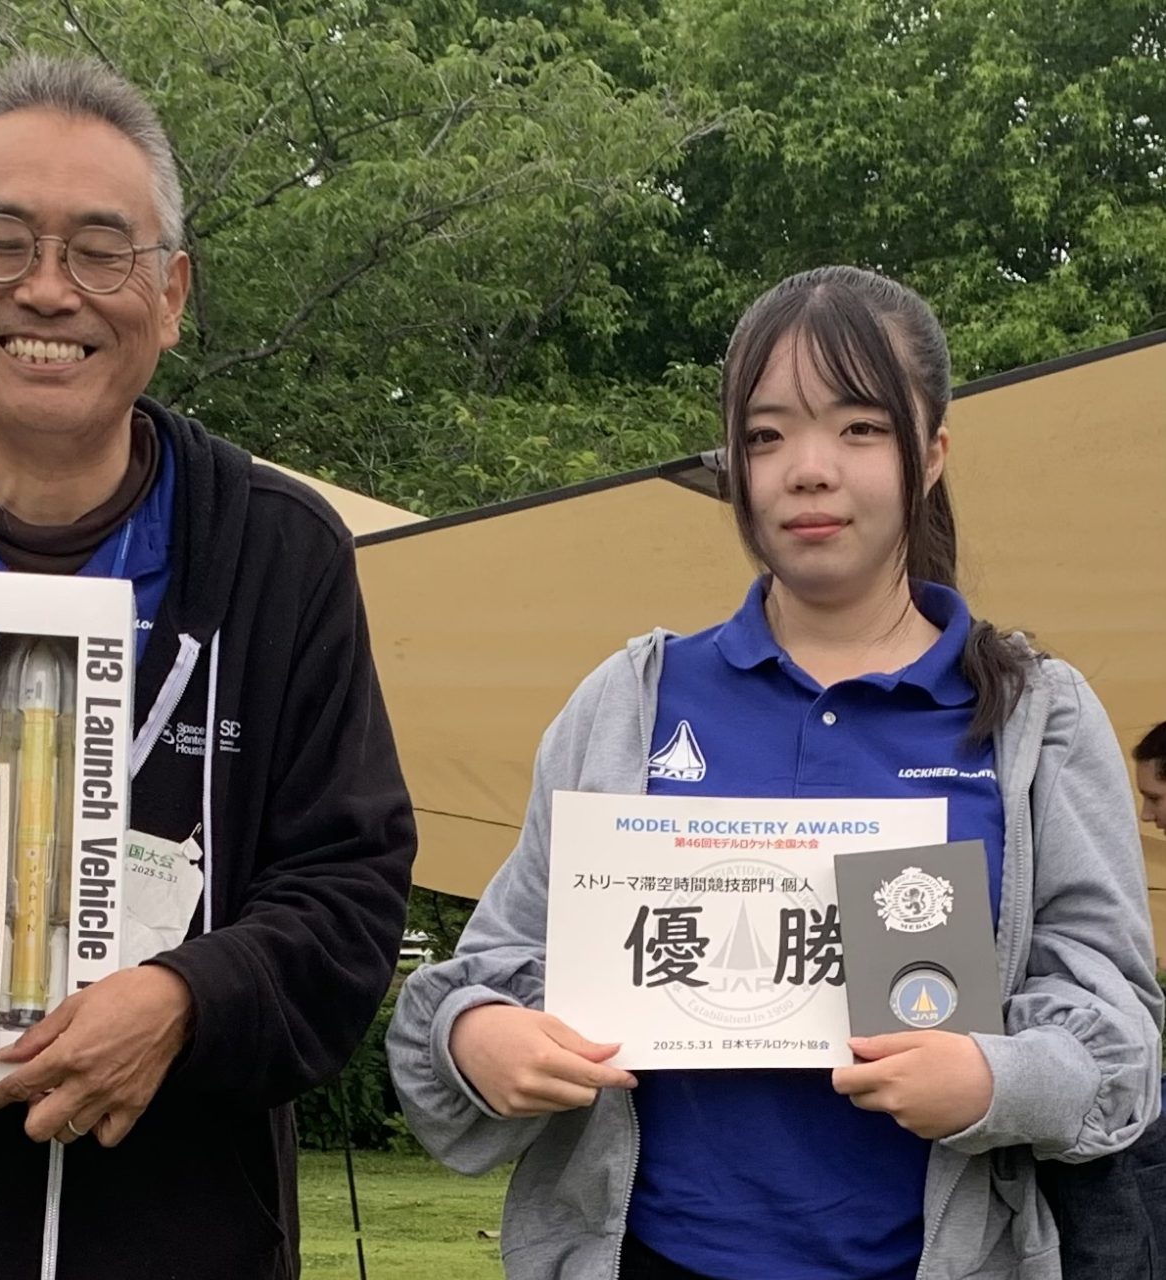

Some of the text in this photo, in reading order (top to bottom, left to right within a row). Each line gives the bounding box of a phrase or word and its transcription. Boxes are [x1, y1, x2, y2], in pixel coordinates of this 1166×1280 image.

[86, 636, 123, 683] H3
[176, 722, 206, 735] Space
[175, 733, 207, 746] Cente
[82, 696, 122, 820] Launch
[898, 767, 958, 778] LOCKHEED
[615, 817, 881, 836] MODEL ROCKETRY AWARDS
[674, 837, 819, 850] 第46回モデルロケット全国大会
[126, 843, 176, 870] 国大会
[131, 863, 178, 883] 2025.5.31
[573, 873, 815, 894] ストリーマ滞空時間競技部門 個人
[77, 837, 118, 960] Vehicle
[900, 921, 933, 931] MEDAL
[910, 1013, 939, 1021] JAR
[653, 1038, 830, 1051] 2025.5.31 日本モデルロケット協会
